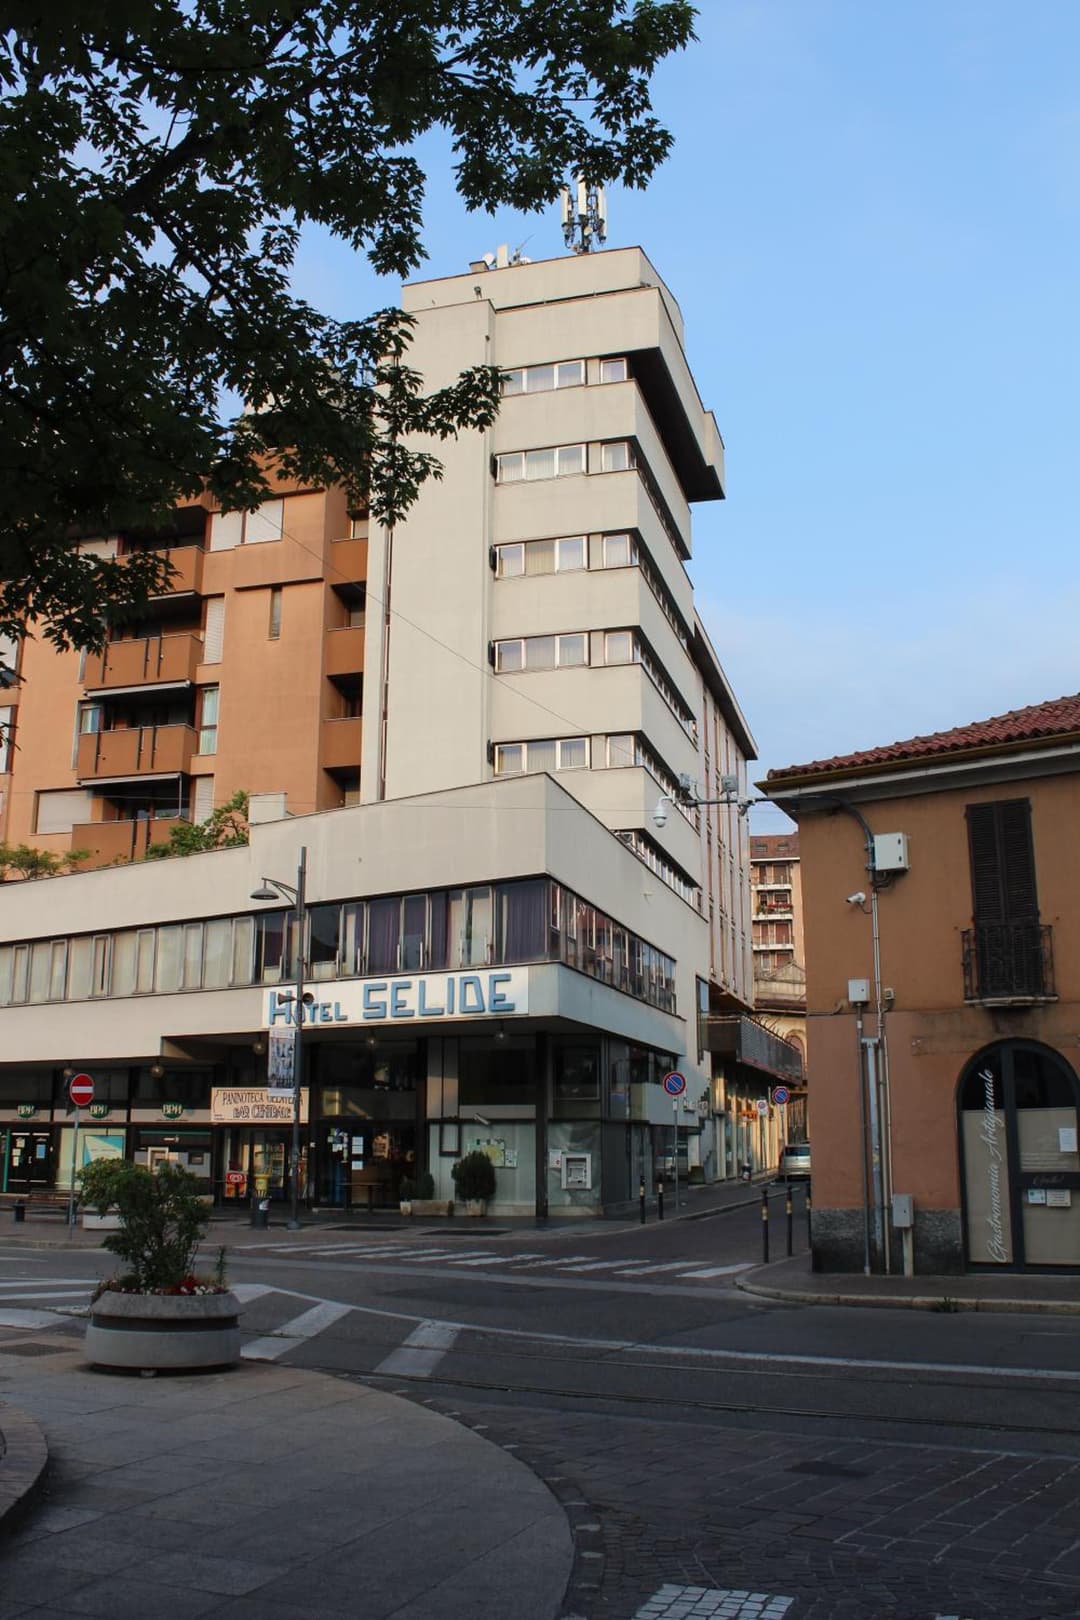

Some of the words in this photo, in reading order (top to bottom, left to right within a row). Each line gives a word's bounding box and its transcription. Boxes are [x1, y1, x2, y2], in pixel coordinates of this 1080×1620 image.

[363, 973, 515, 1019] SELIDE
[978, 1068, 1005, 1161] Artigianale
[986, 1164, 1009, 1263] Gastronomia
